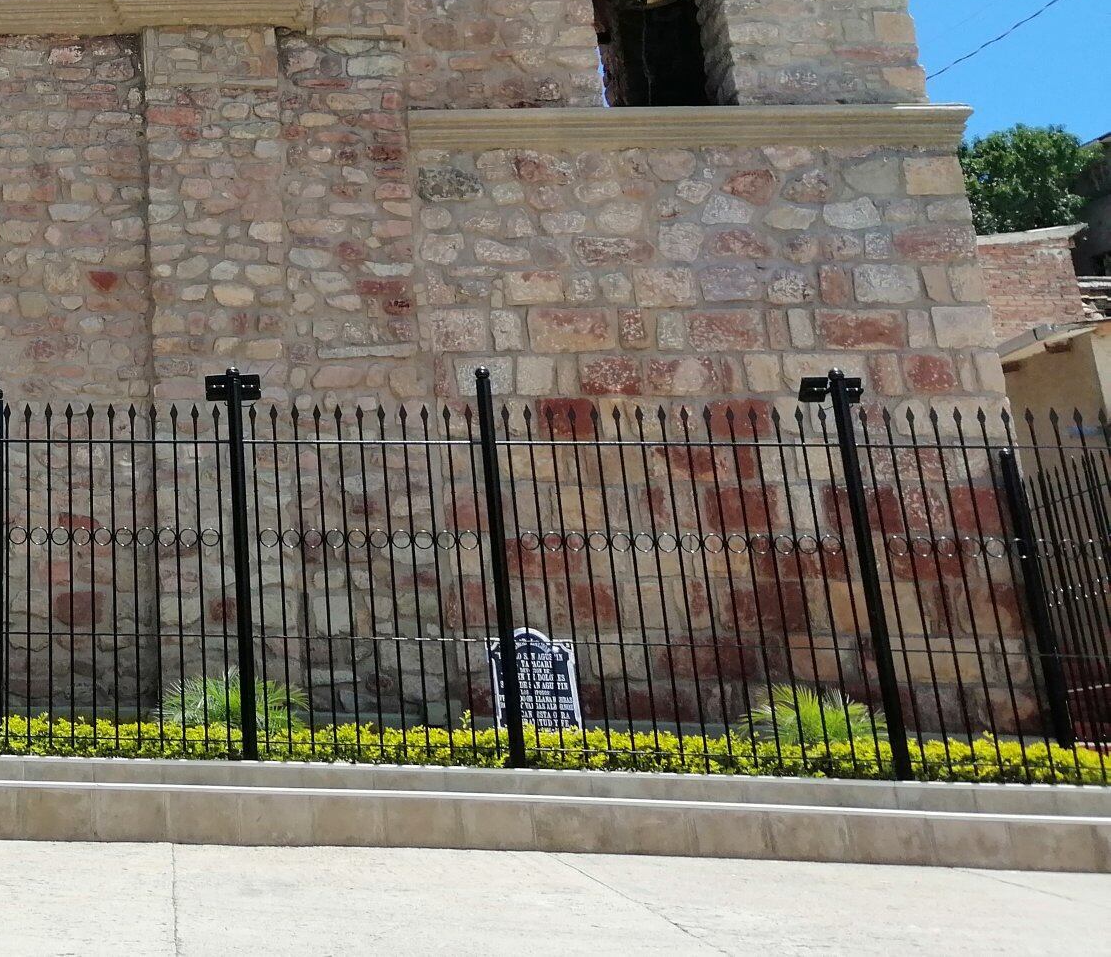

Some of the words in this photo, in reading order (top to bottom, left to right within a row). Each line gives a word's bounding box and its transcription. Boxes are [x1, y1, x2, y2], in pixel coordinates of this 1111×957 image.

[537, 652, 564, 662] AGUSIN
[521, 660, 553, 669] TAACARI
[538, 673, 566, 682] DOLOES
[541, 681, 569, 690] AGUTIN
[552, 710, 571, 720] ORA
